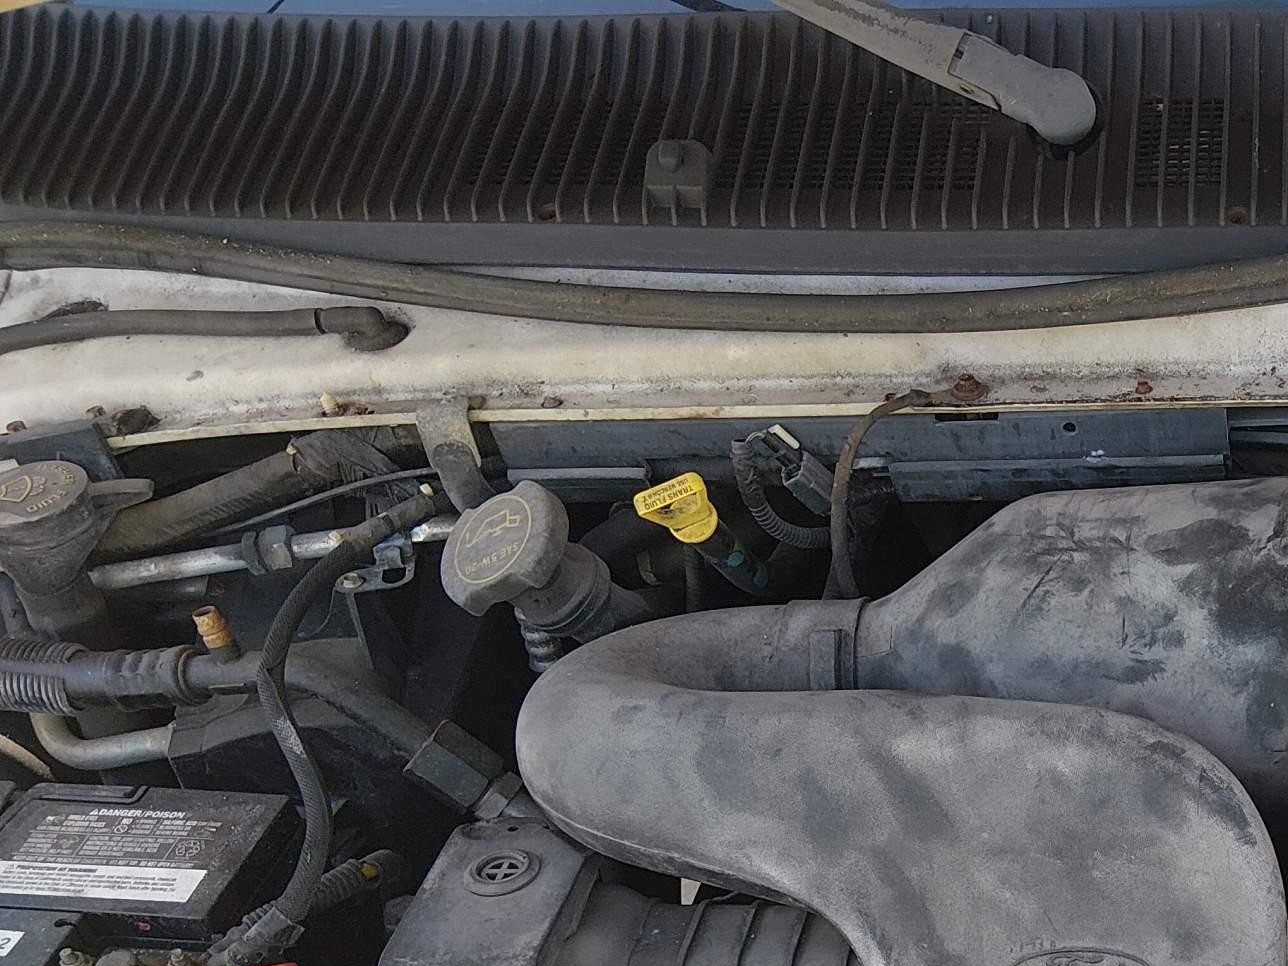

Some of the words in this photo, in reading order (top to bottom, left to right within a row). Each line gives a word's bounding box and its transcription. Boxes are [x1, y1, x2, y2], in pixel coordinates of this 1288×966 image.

[667, 485, 695, 501] TRANS
[644, 495, 667, 511] FLUID
[500, 542, 519, 559] SAE
[98, 809, 186, 818] DANGER/POISON
